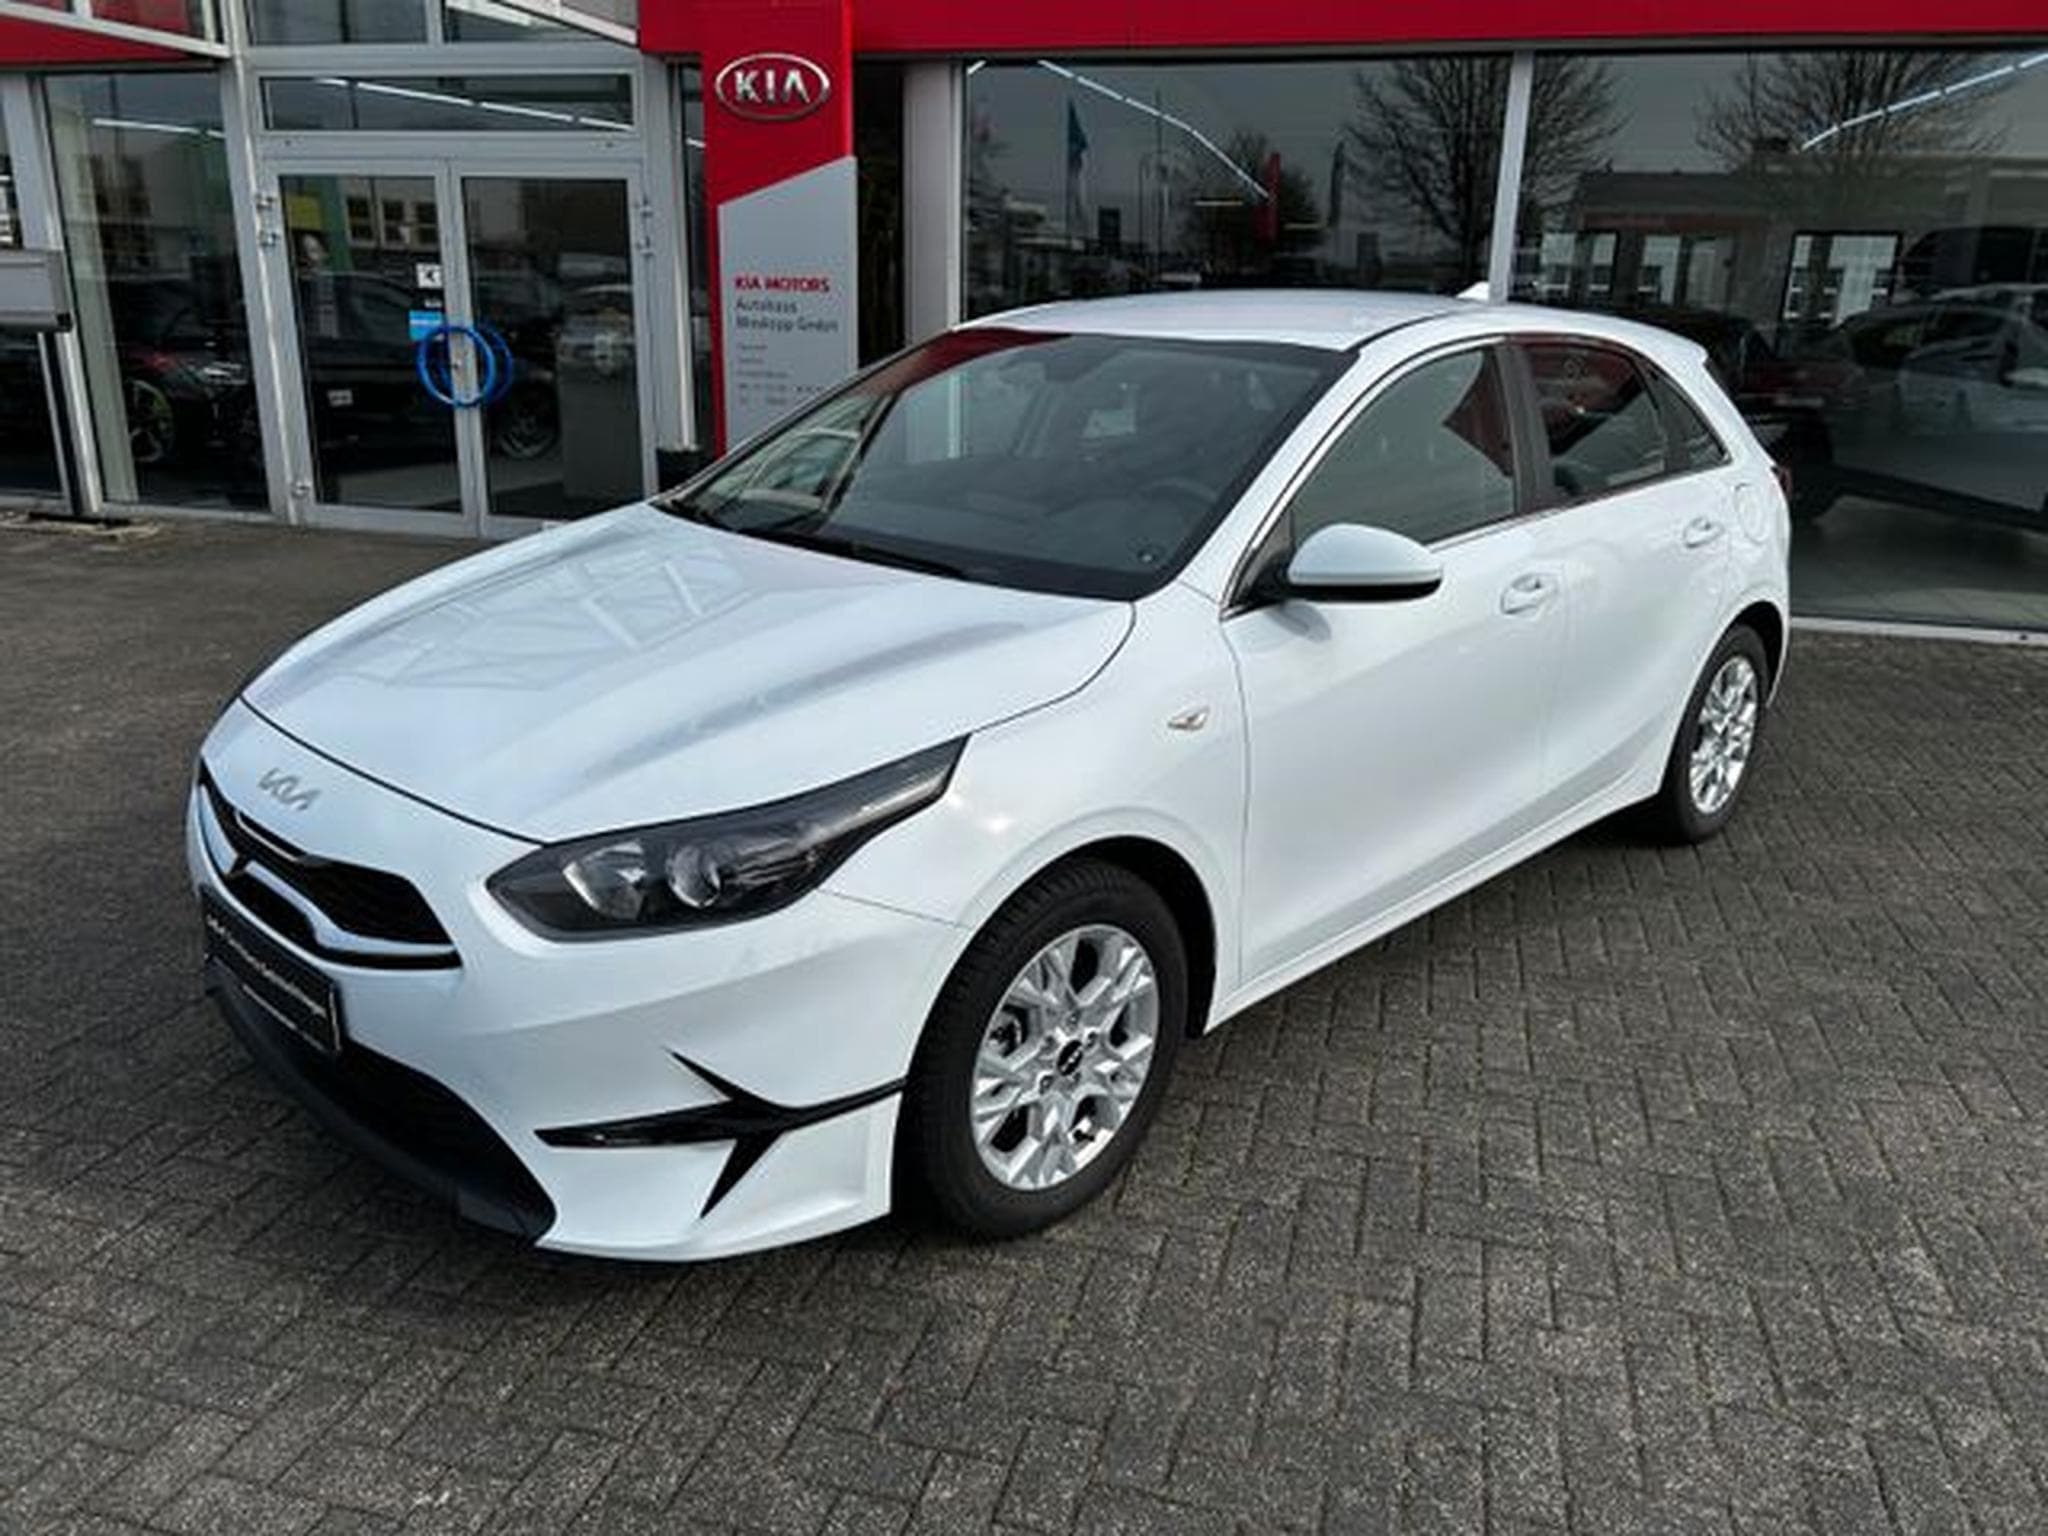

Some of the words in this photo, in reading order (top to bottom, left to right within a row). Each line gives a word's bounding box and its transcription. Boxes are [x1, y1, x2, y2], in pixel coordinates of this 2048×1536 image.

[734, 69, 811, 103] KIA
[735, 275, 762, 290] KIA
[766, 276, 831, 293] MOTORS
[736, 299, 798, 313] Autohaus
